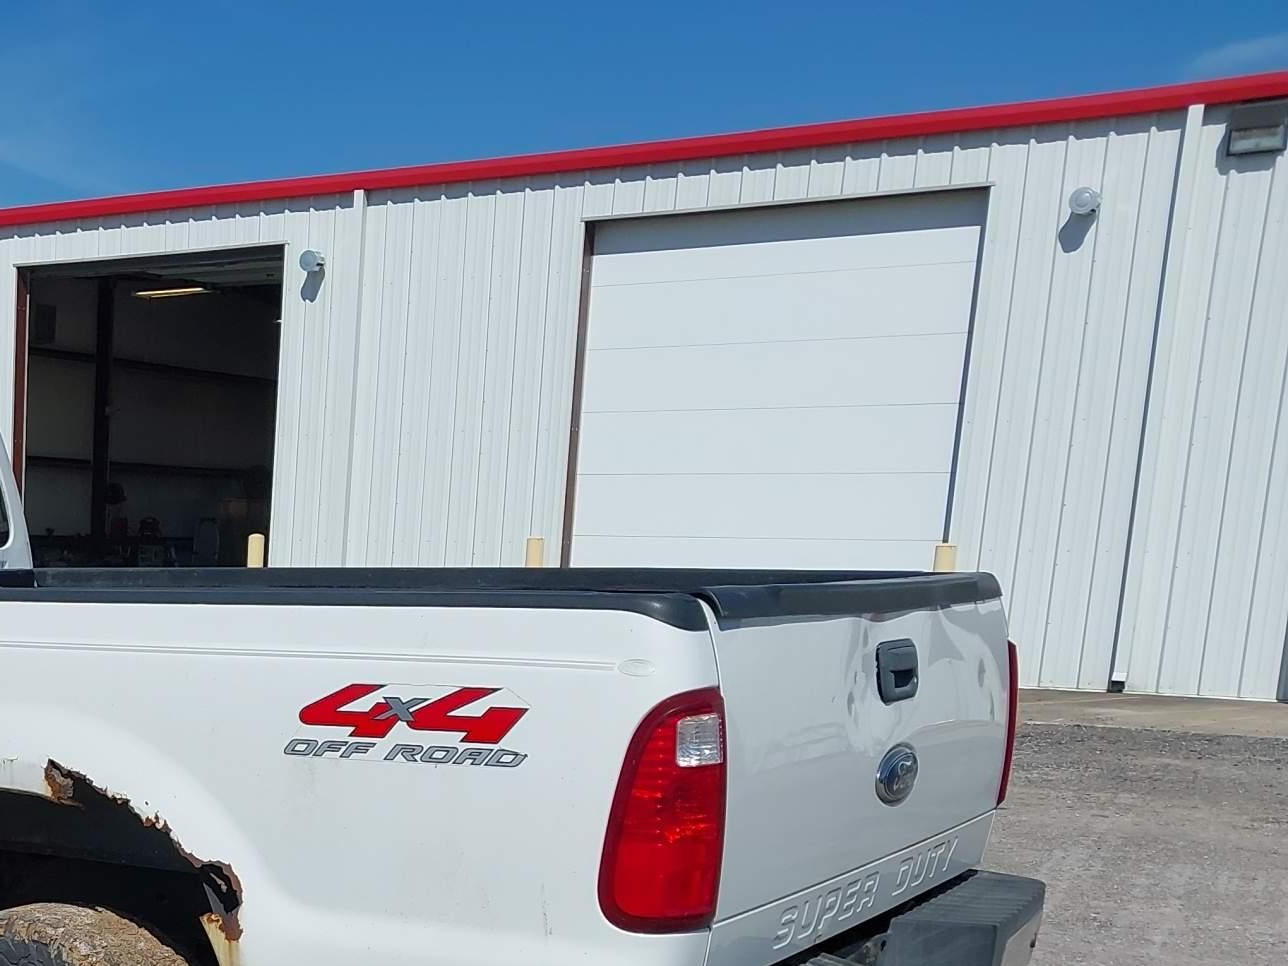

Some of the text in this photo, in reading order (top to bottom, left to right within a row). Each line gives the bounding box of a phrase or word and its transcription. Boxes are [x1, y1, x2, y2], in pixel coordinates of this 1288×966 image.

[284, 738, 528, 768] OFF ROAD
[773, 835, 959, 949] SUPER DUTY
